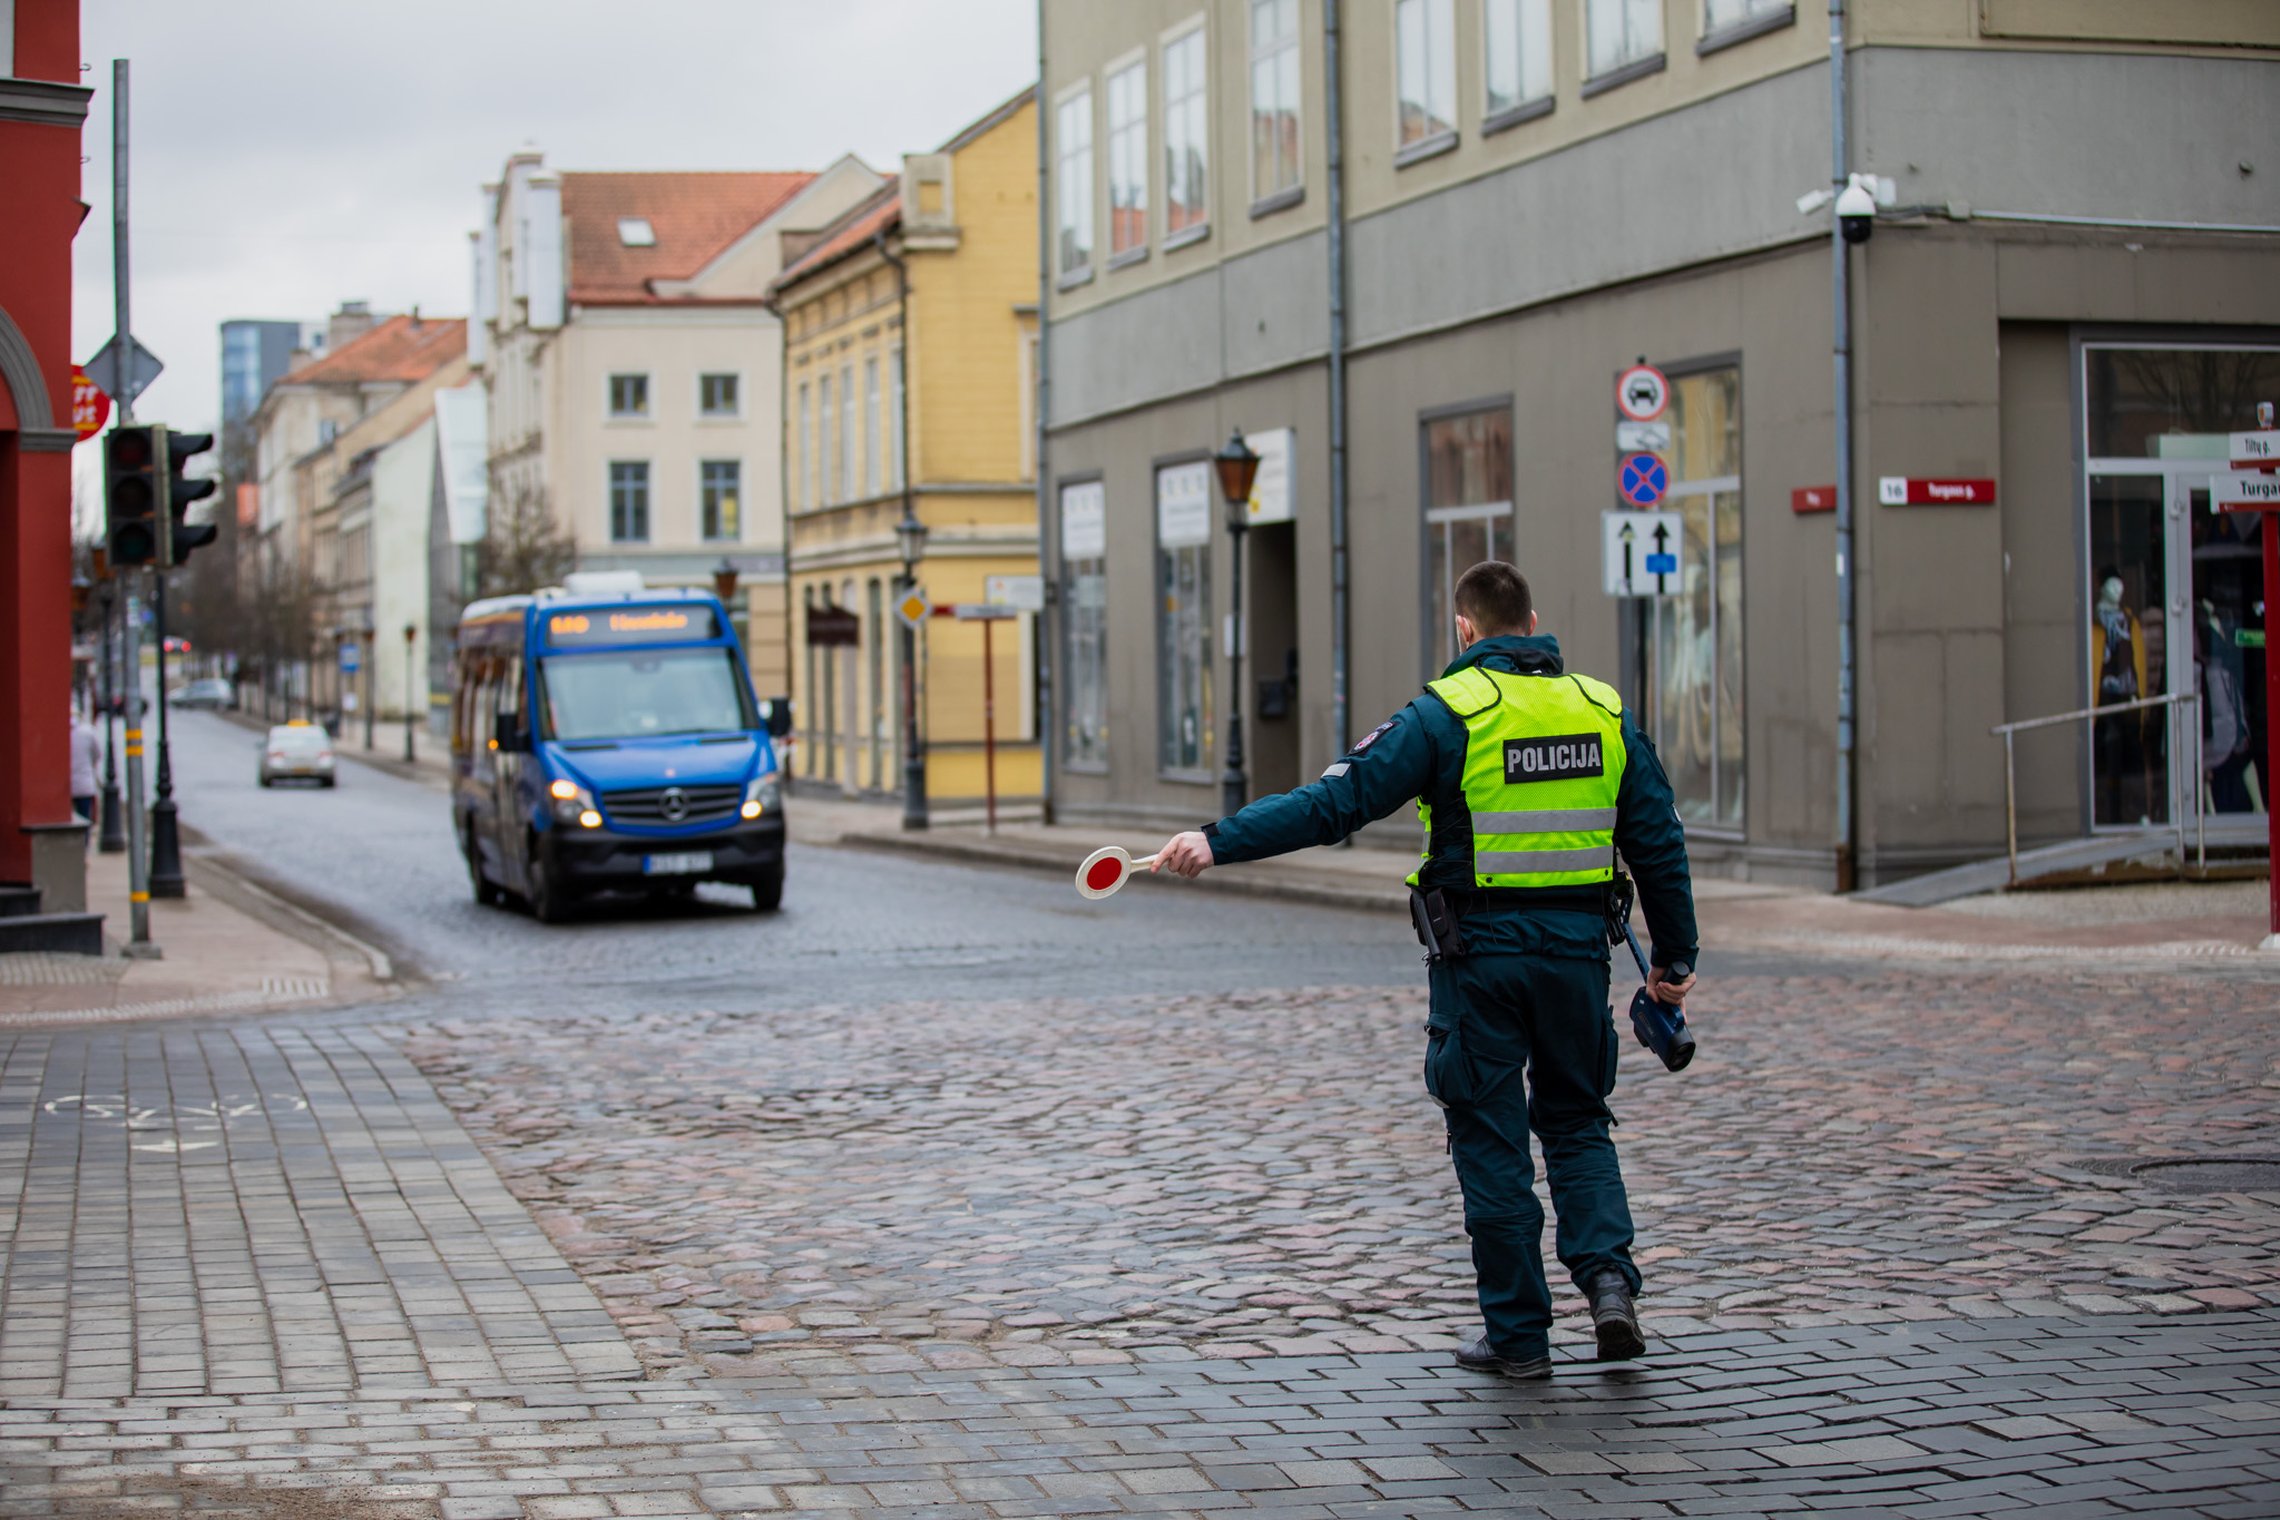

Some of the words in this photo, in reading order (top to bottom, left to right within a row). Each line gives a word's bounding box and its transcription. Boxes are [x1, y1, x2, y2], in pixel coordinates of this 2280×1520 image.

[1887, 484, 1903, 498] 16
[2240, 480, 2280, 499] Turga
[1507, 743, 1601, 773] POLICIJA
